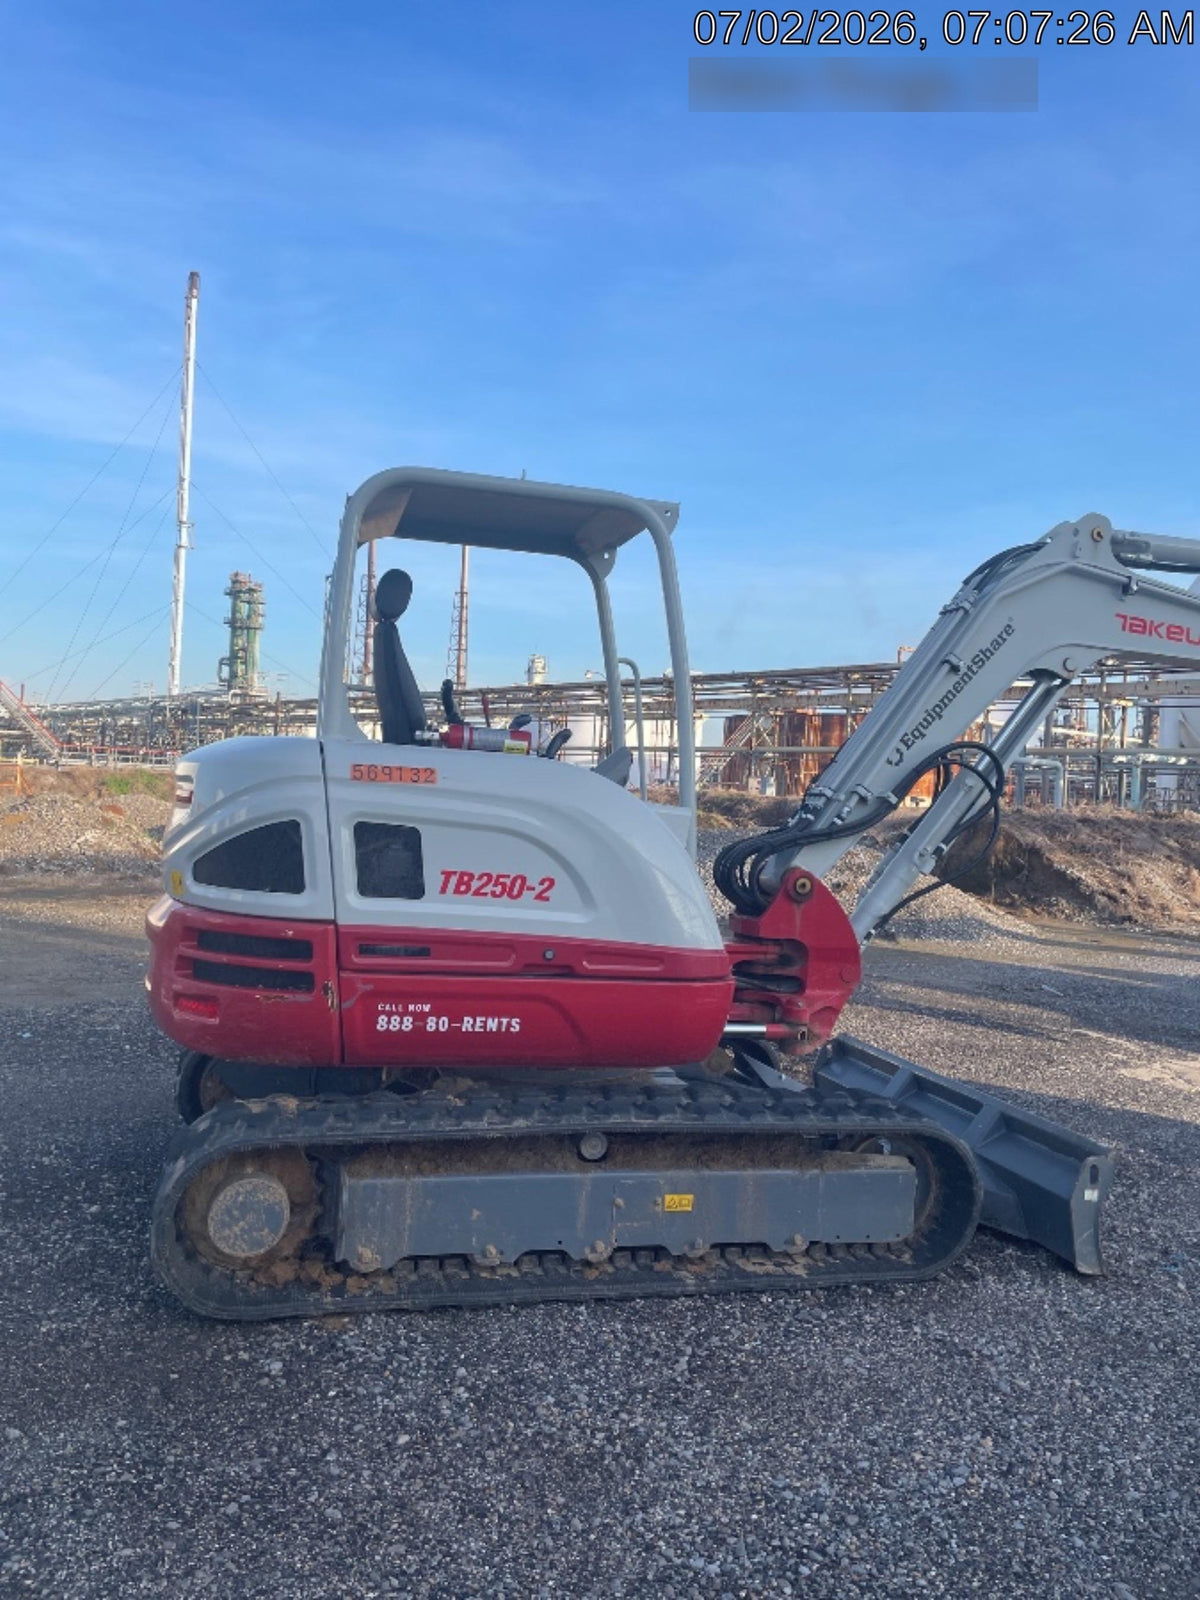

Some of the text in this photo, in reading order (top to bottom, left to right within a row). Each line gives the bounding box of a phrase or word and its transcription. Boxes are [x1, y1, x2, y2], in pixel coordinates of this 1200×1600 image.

[900, 623, 1015, 750] EquipmentShare
[351, 763, 435, 784] 569132
[439, 869, 556, 902] TB250-2
[377, 1003, 431, 1013] CALL NOW
